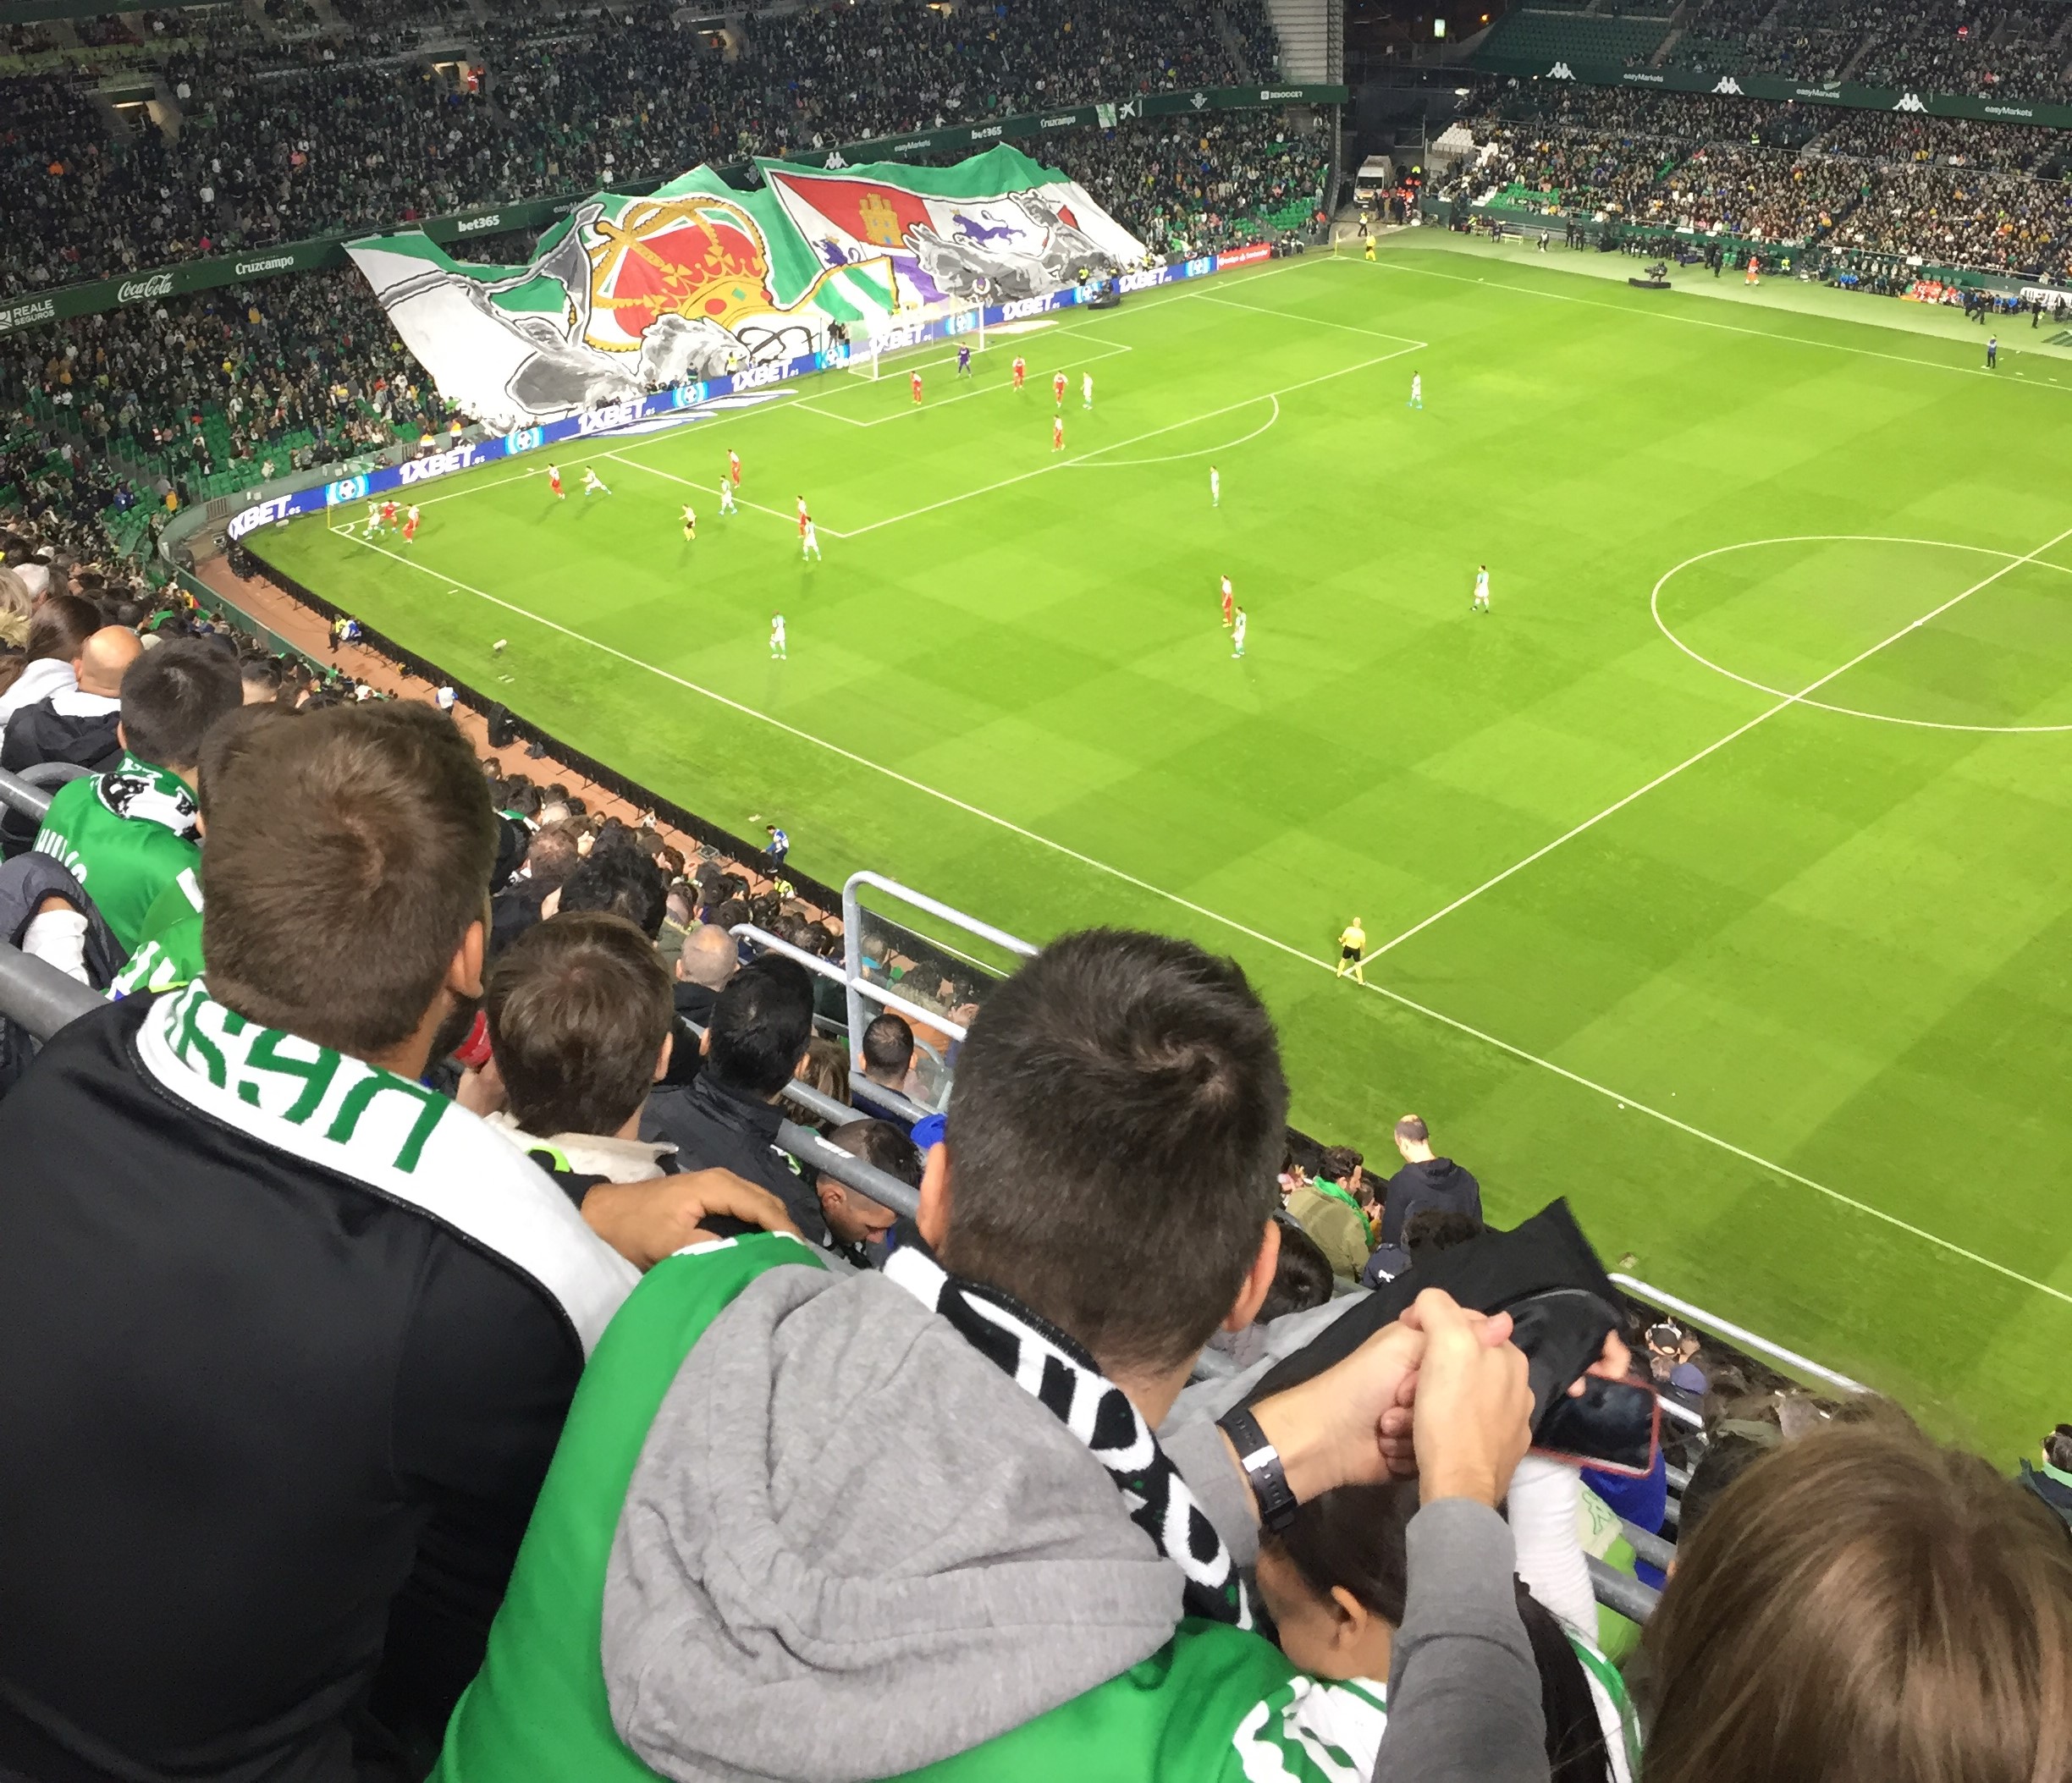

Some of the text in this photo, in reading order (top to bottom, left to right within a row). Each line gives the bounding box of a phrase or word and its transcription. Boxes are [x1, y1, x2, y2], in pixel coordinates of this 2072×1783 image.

[1984, 106, 2033, 117] easyMarkets
[1040, 115, 1077, 129] Cruzcampo
[971, 126, 1002, 140] bet365
[458, 214, 501, 233] bet365
[235, 256, 295, 275] Cruzcampo
[117, 272, 174, 303] Coca-Cola
[13, 299, 53, 319] REALE
[14, 309, 56, 327] SEGUROS
